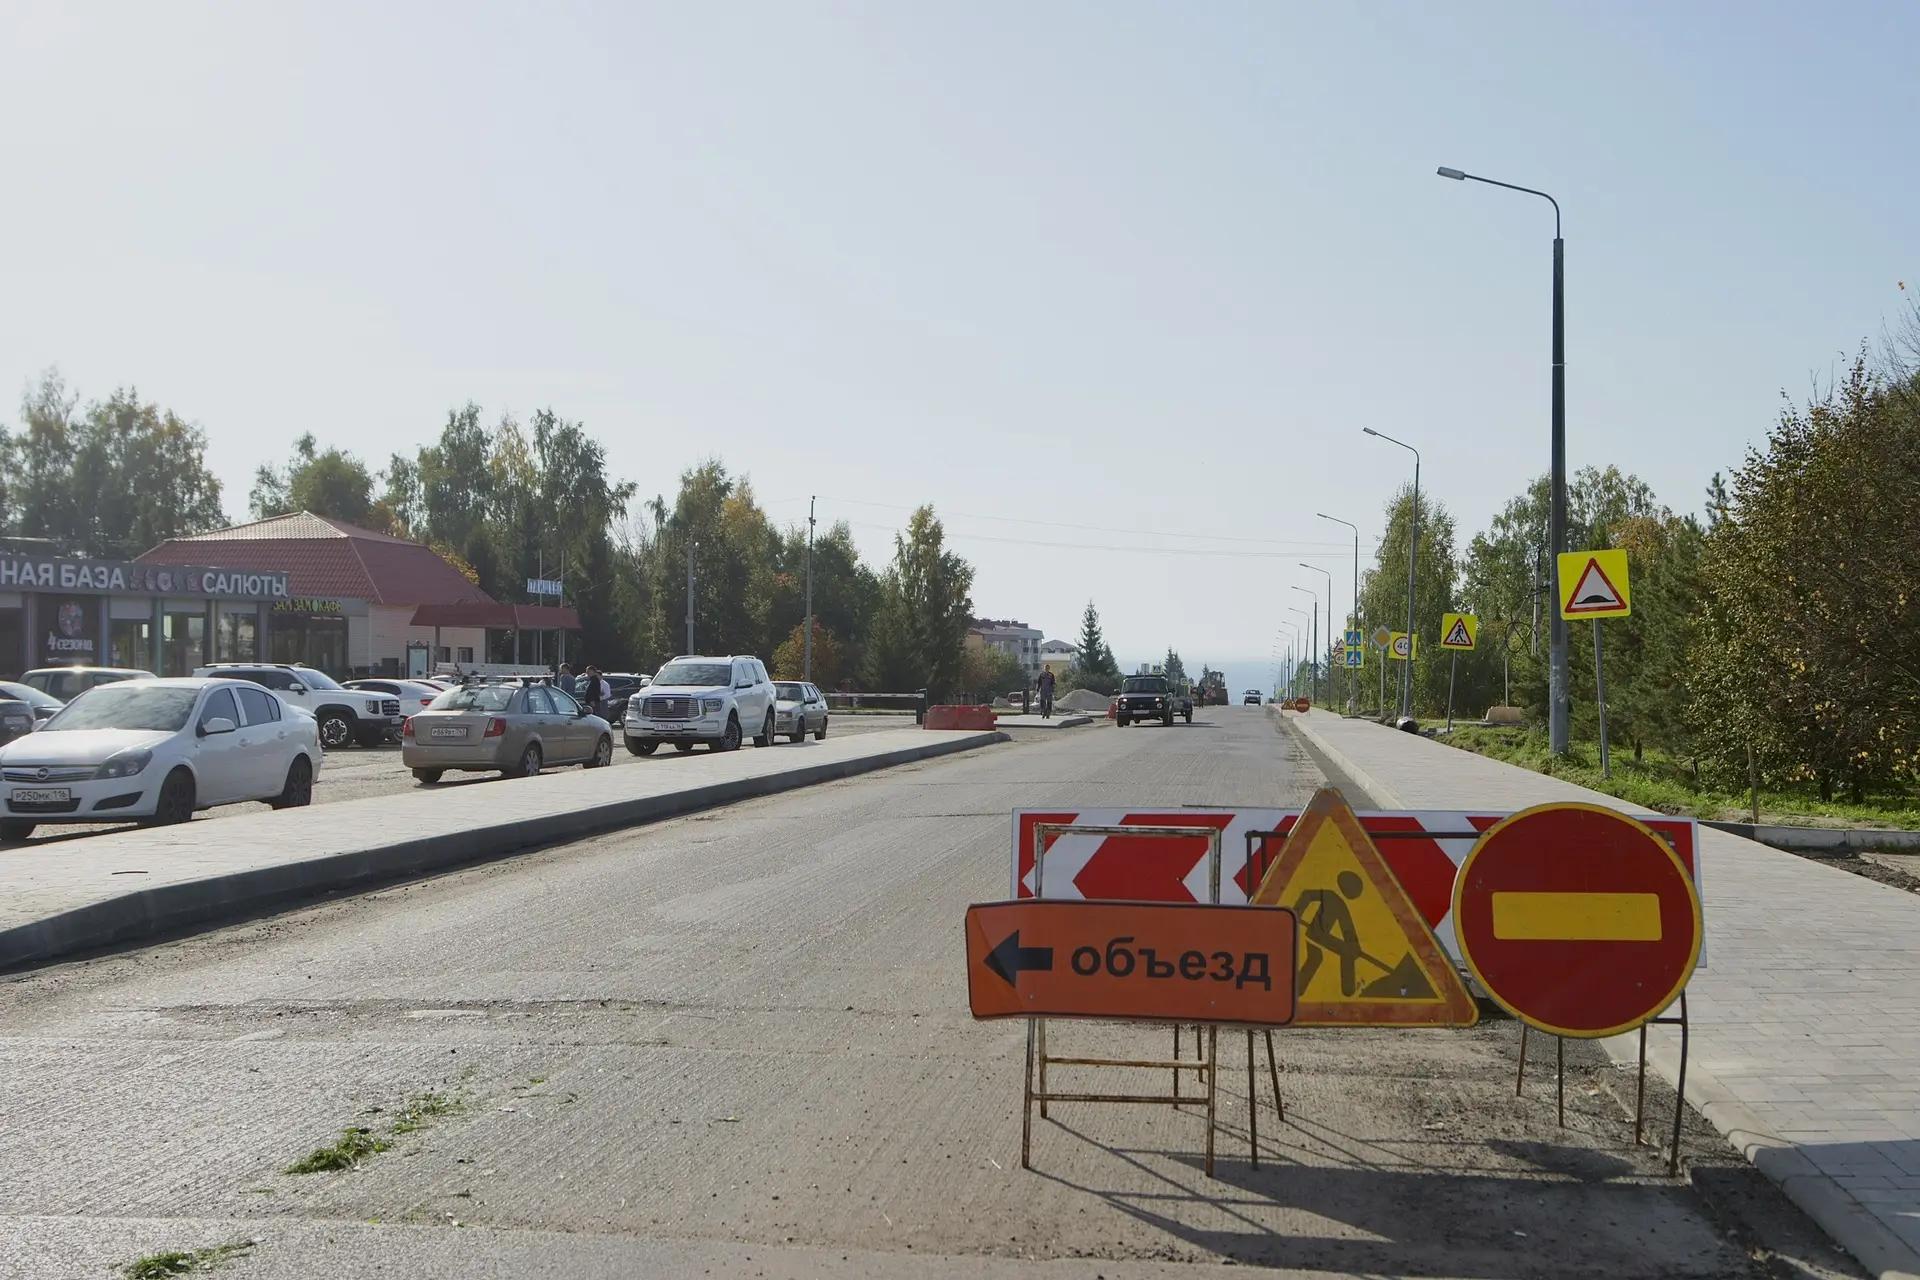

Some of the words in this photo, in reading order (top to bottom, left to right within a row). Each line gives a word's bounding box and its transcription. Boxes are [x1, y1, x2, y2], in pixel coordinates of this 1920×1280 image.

[60, 564, 125, 590] БАЗА
[202, 572, 288, 598] САЛЮТЫ
[1071, 936, 1272, 992] объезд
